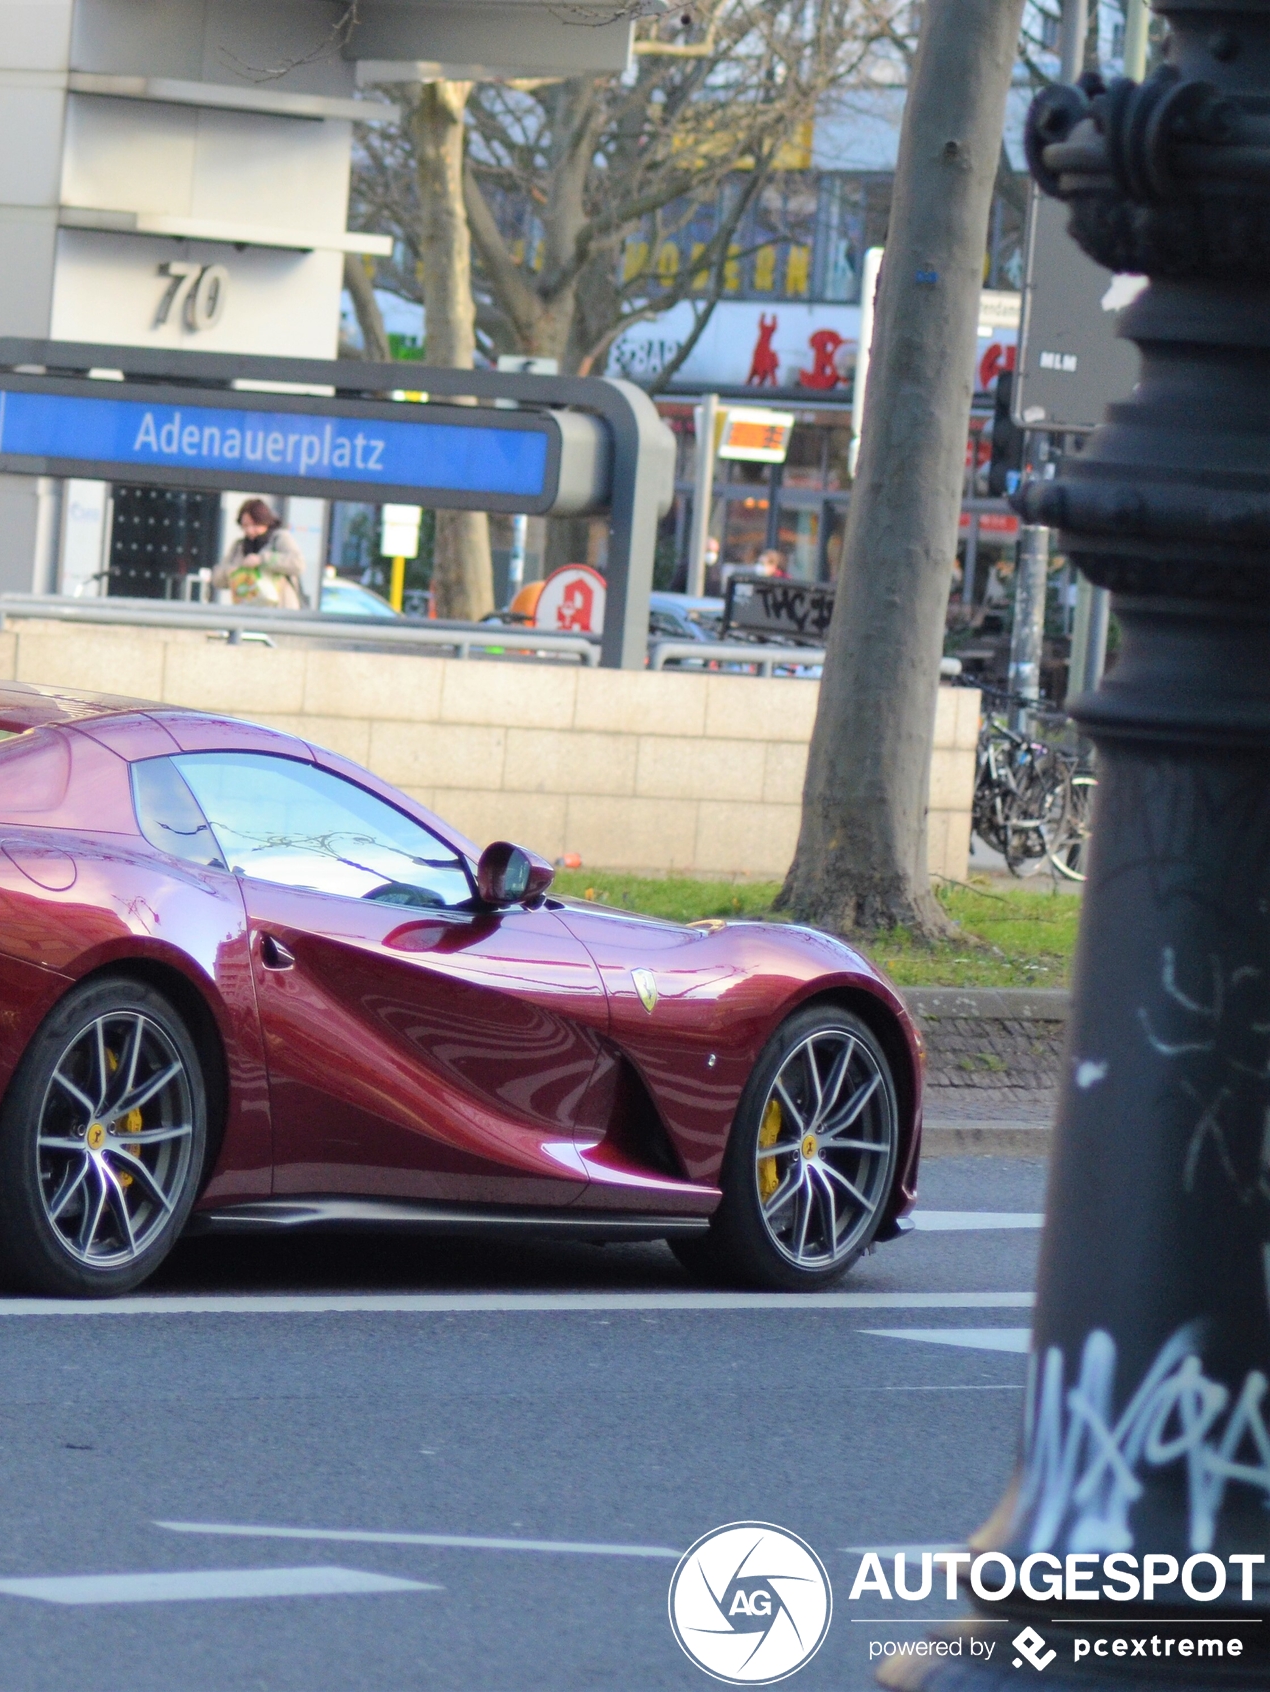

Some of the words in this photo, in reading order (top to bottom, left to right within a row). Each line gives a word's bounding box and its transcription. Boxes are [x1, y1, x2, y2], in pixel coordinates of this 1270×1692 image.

[150, 261, 229, 334] 70
[1040, 351, 1078, 372] MLM
[134, 412, 386, 476] Adenauerplatz
